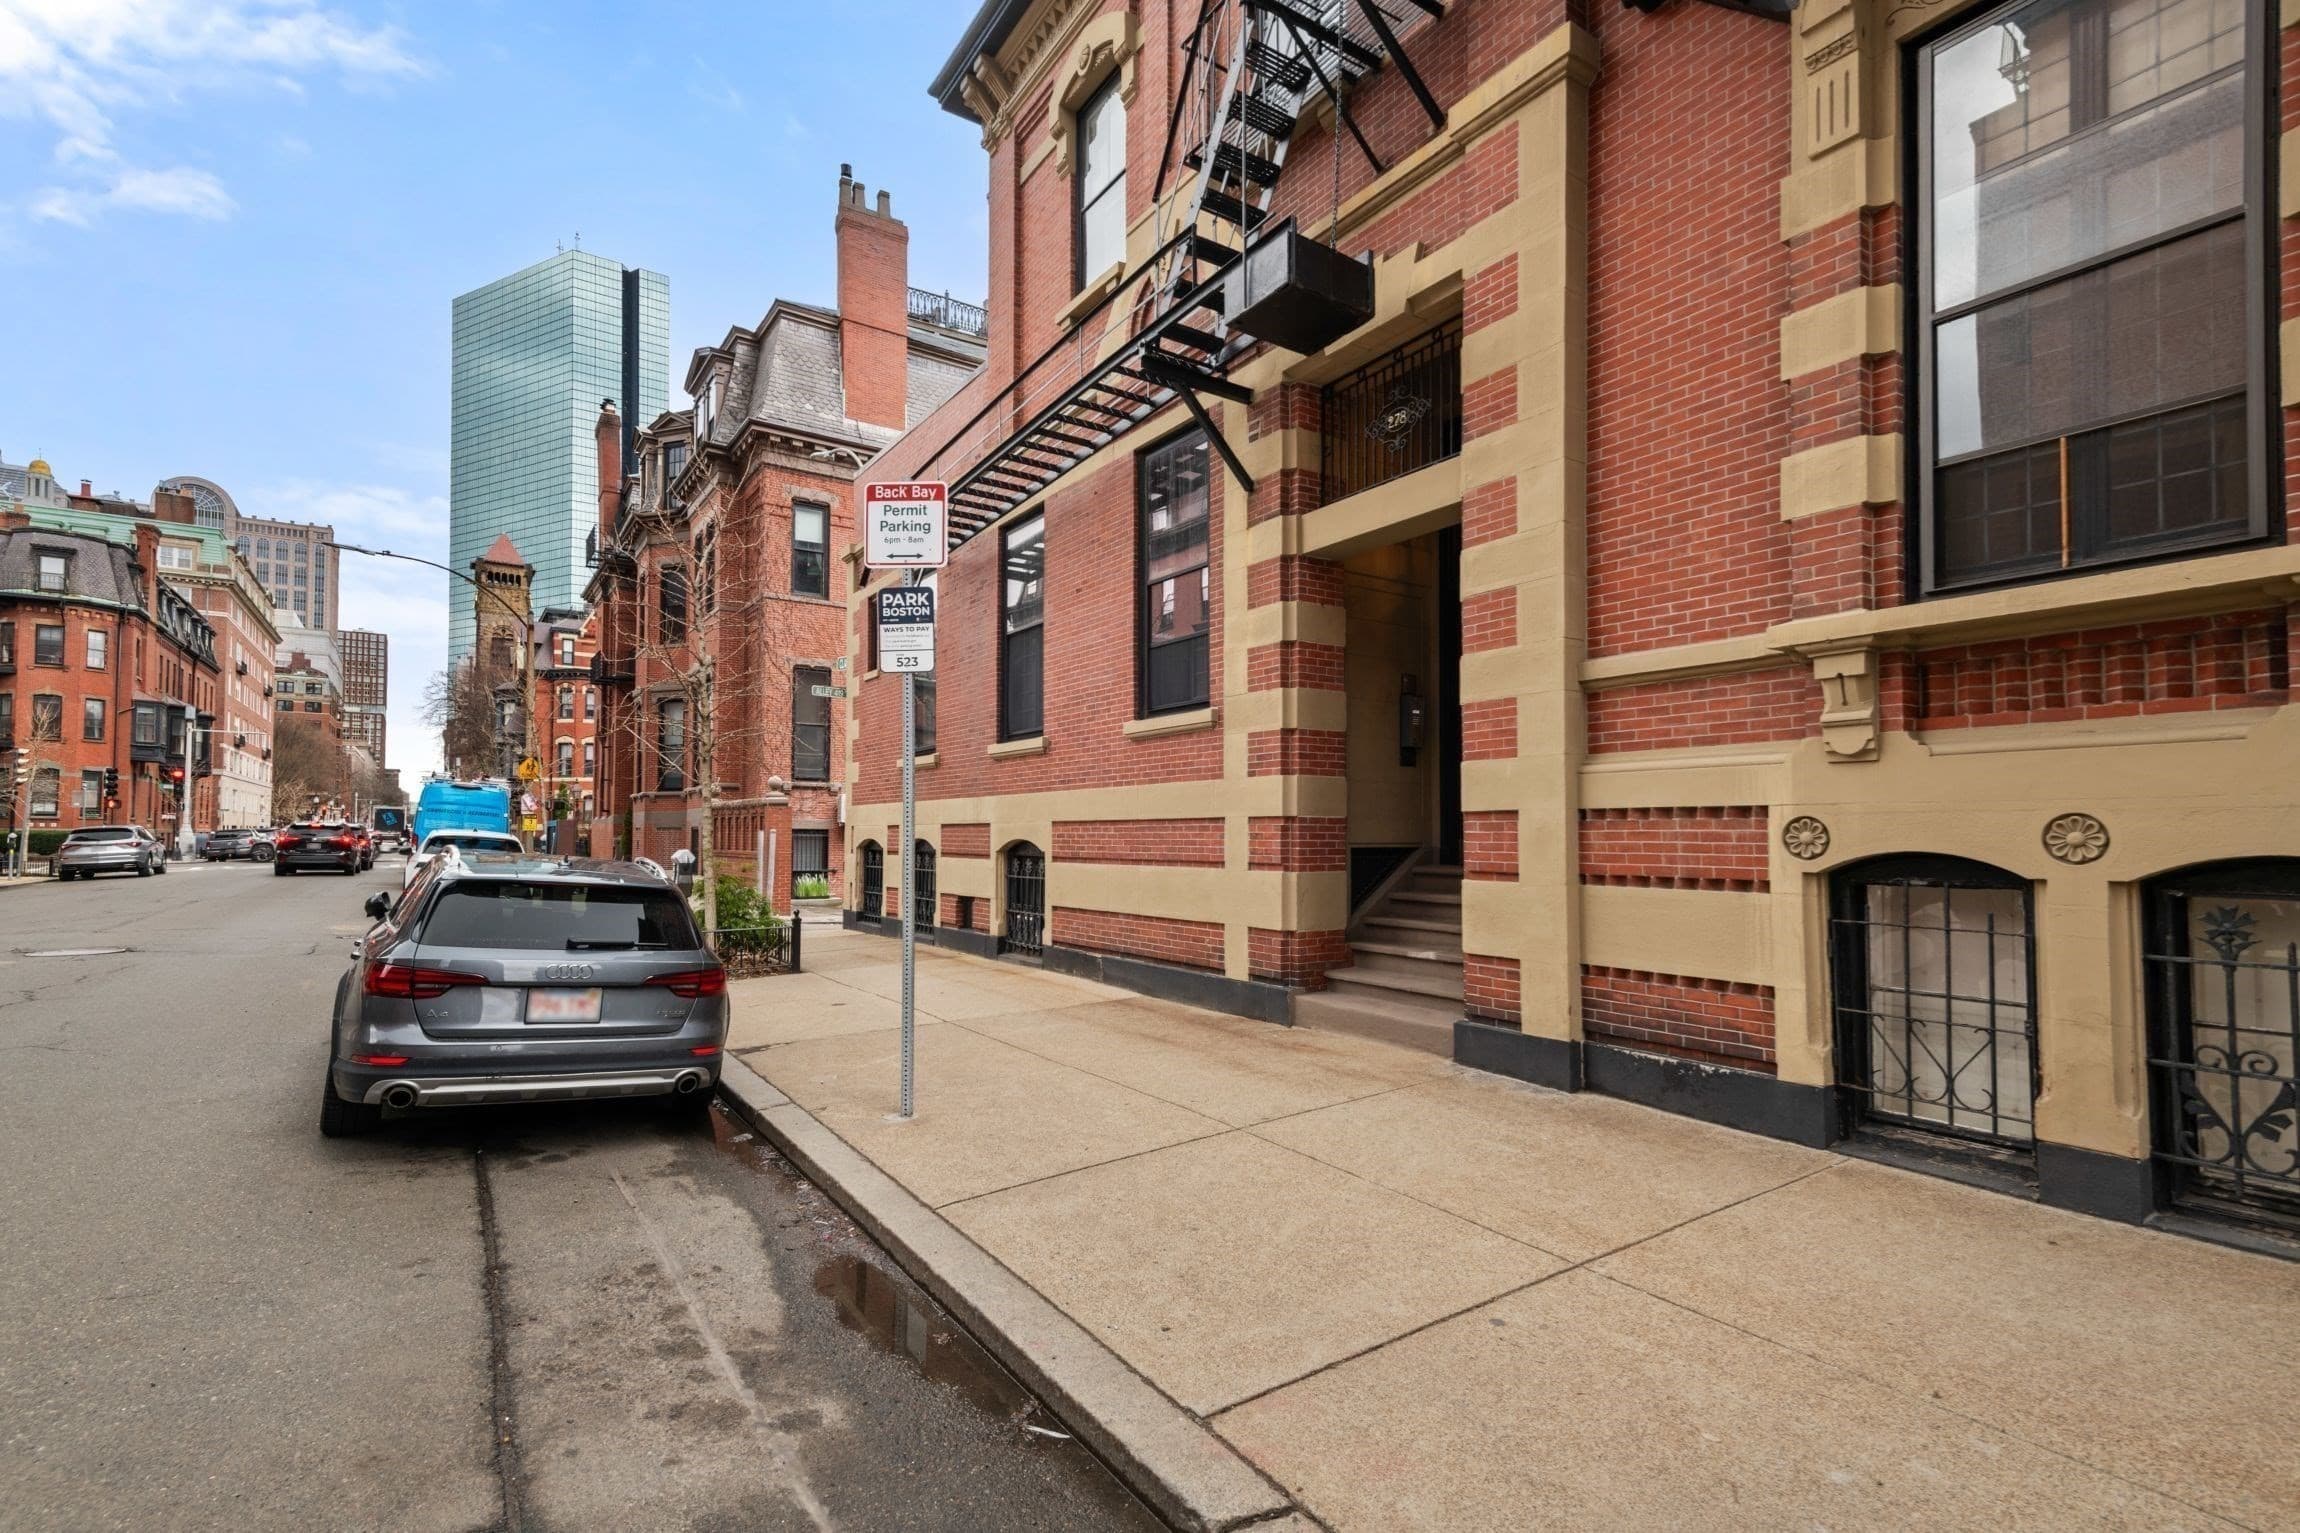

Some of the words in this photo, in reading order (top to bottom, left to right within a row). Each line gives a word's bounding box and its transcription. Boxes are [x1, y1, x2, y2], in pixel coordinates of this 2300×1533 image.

[1387, 410, 1407, 429] 278
[875, 485, 908, 499] Back
[912, 485, 937, 500] Bay
[883, 503, 928, 516] Permit
[880, 520, 931, 534] Parking
[882, 592, 929, 607] PARK
[882, 606, 930, 617] BOSTON
[896, 656, 919, 667] 523
